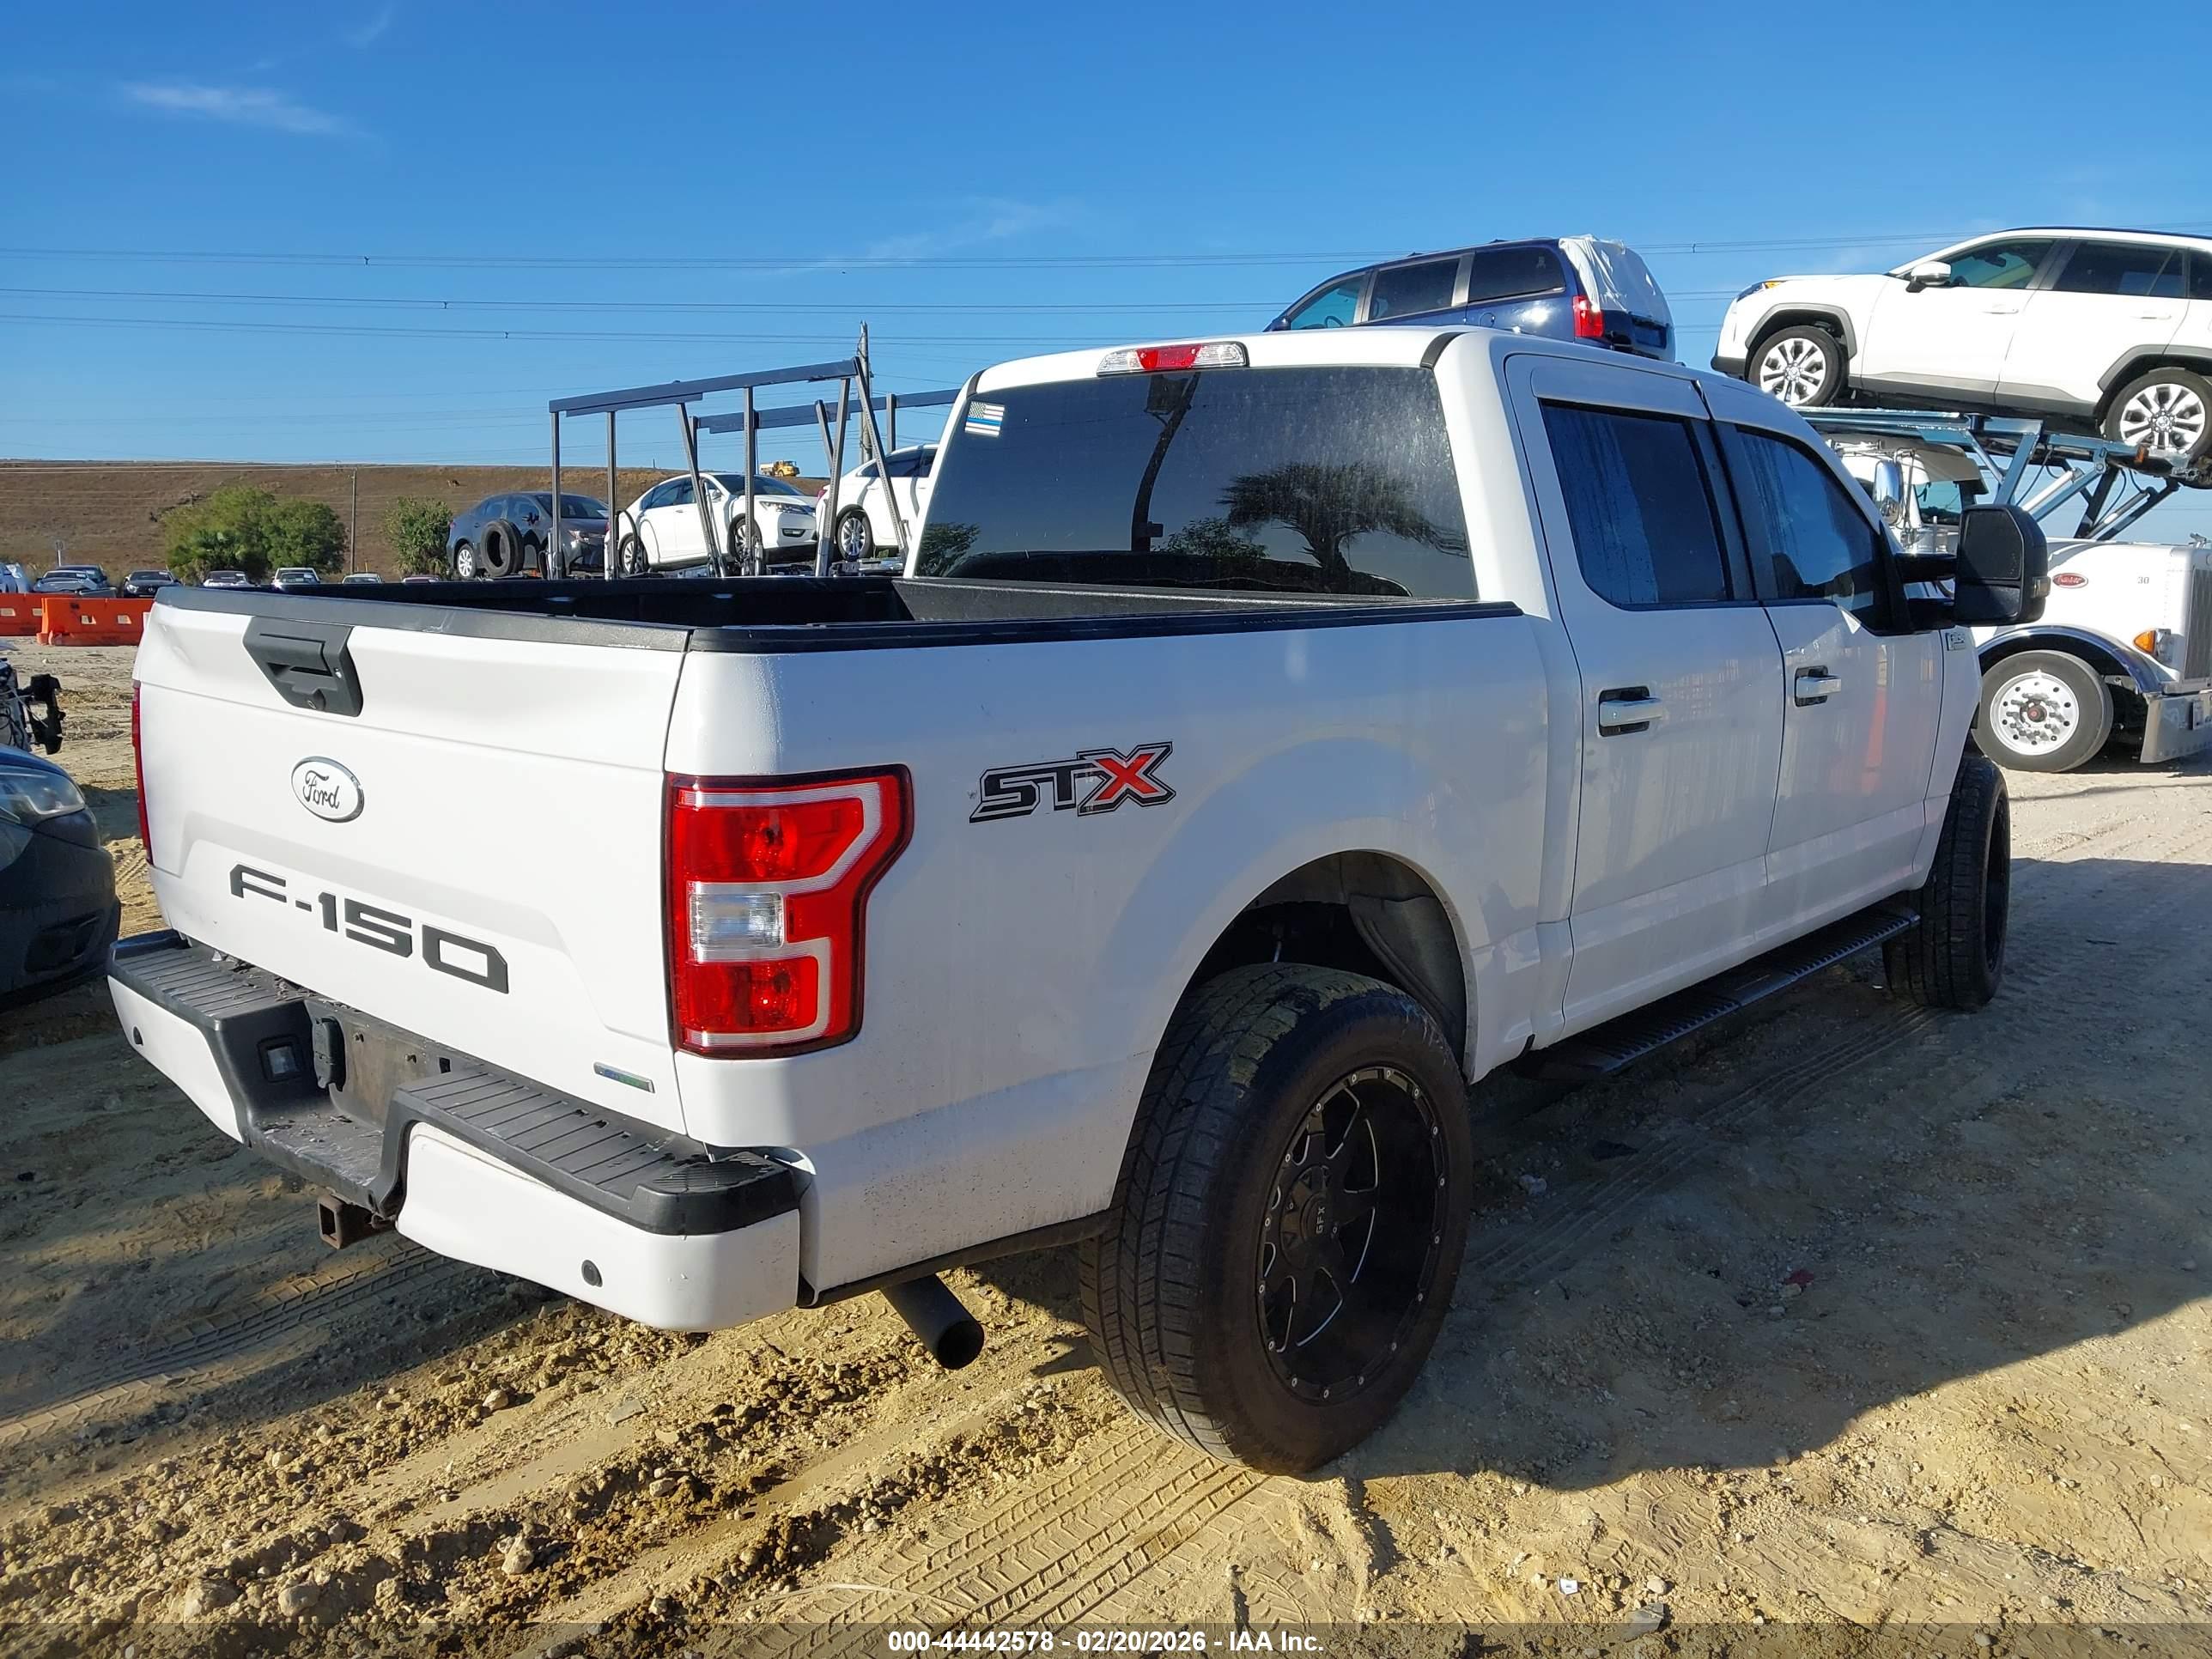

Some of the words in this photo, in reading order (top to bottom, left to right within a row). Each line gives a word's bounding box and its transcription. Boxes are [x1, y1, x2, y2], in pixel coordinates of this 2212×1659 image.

[302, 769, 340, 810] Ford
[969, 741, 1176, 823] STX
[229, 863, 509, 994] F-150
[1316, 1206, 1326, 1235] GFX
